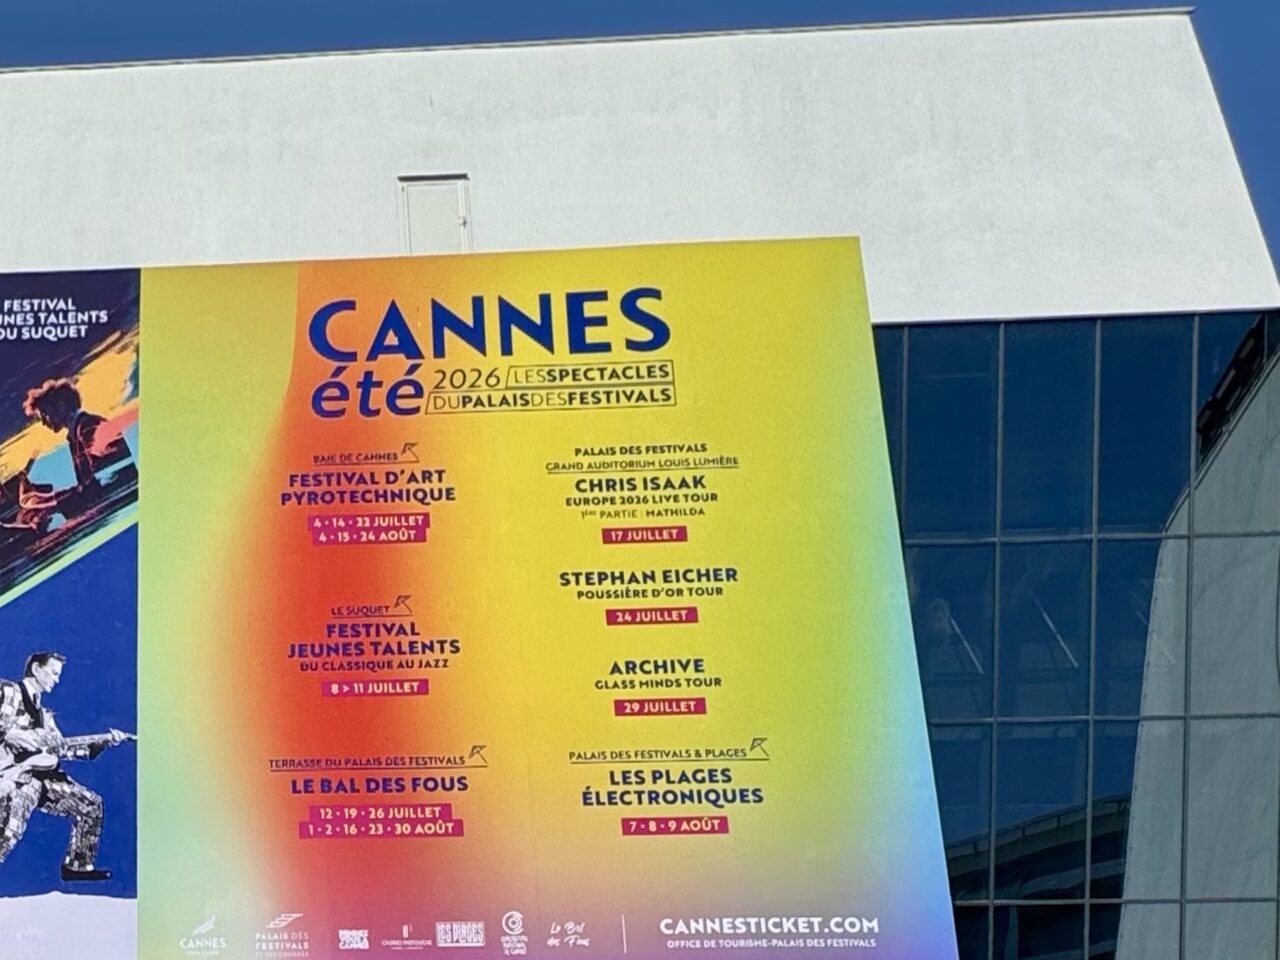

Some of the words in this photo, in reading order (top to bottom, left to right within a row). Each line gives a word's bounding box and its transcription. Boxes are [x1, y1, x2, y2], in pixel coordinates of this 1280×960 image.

[4, 298, 76, 312] FESTIVAL
[38, 311, 108, 324] TALENTS
[308, 287, 671, 363] CANNES
[22, 325, 88, 341] SUQUET
[433, 368, 501, 389] 2026
[311, 358, 423, 418] été
[575, 447, 617, 457] PALAIS
[620, 446, 642, 455] DES
[645, 444, 708, 455] FESTIVALS
[314, 454, 336, 464] BAIE
[340, 454, 353, 463] DE
[356, 453, 399, 462] CANNES
[546, 462, 584, 471] GRAND
[587, 460, 655, 470] AUDITORIUM
[659, 459, 691, 468] LOUIS
[289, 472, 379, 488] FESTIVAL
[575, 477, 637, 493] CHRIS
[643, 475, 707, 490] ISAAK
[281, 488, 456, 506] PYROTECHNIQUE
[566, 497, 617, 507] EUROPE
[620, 496, 649, 505] 2026
[652, 495, 680, 504] LIVE
[683, 493, 718, 503] TOUR
[600, 510, 638, 519] PARTIE
[646, 508, 705, 518] MATHILDA
[314, 519, 322, 528] 4
[333, 518, 346, 528] 14
[356, 518, 370, 527] 22
[373, 516, 424, 528] JUILLET
[319, 533, 327, 542] 4
[338, 532, 350, 542] 15
[360, 531, 375, 541] 24
[379, 528, 417, 541] AOÛT
[611, 531, 623, 541] 17
[626, 529, 679, 541] JUILLET
[560, 570, 656, 587] STEPHAN
[663, 568, 738, 583] EICHER
[577, 586, 648, 600] POUSSIÈRE
[687, 587, 723, 596] TOUR
[332, 607, 344, 616] LE
[346, 606, 390, 616] SUQUET
[616, 613, 632, 622] 24
[635, 610, 688, 622] JUILLET
[327, 622, 420, 638] FESTIVAL
[288, 643, 365, 659] JEUNES
[370, 640, 461, 656] TALENTS
[300, 662, 318, 672] DU
[322, 660, 393, 673] CLASSIQUE
[397, 660, 414, 669] AU
[418, 659, 449, 669] JAZZ
[610, 659, 705, 676] ARCHIVE
[331, 684, 339, 694] 8
[353, 684, 364, 694] 11
[367, 682, 420, 694] JUILLET
[595, 680, 636, 690] GLASS
[639, 679, 682, 689] MINDS
[685, 678, 722, 687] TOUR
[624, 703, 640, 713] 29
[643, 701, 696, 713] JUILLET
[569, 751, 607, 760] PALAIS
[611, 750, 632, 760] DES
[635, 750, 691, 759] FESTIVALS
[706, 748, 747, 758] PLAGES
[269, 759, 321, 769] TERRASSE
[325, 759, 341, 767] DU
[345, 758, 382, 767] PALAIS
[386, 757, 406, 766] DES
[409, 756, 465, 766] FESTIVALS
[610, 770, 645, 785] LES
[652, 768, 733, 785] PLAGES
[291, 779, 315, 794] LE
[320, 778, 360, 793] BAL
[366, 777, 406, 793] DES
[412, 776, 469, 792] FOUS
[582, 786, 764, 808] ÉLECTRONIQUES
[320, 809, 333, 820] 12
[344, 808, 357, 819] 19
[369, 808, 385, 819] 26
[388, 806, 442, 819] JUILLET
[309, 824, 314, 836] 1
[325, 824, 333, 835] 2
[344, 824, 357, 835] 16
[369, 824, 384, 834] 23
[395, 823, 411, 834] 30
[415, 820, 454, 834] AOÛT
[630, 822, 636, 833] 7
[649, 821, 657, 831] 8
[669, 821, 676, 831] 9
[680, 818, 720, 831] AOÛT
[659, 916, 880, 935] CANNESTICKET.COM
[256, 932, 289, 941] PALAIS
[292, 932, 309, 940] DES
[667, 940, 702, 949] OFFICE
[704, 940, 717, 949] DE
[807, 939, 825, 947] DES
[827, 938, 877, 948] FESTIVALS
[180, 938, 227, 950] CANNES
[256, 941, 309, 950] FESTIVALS
